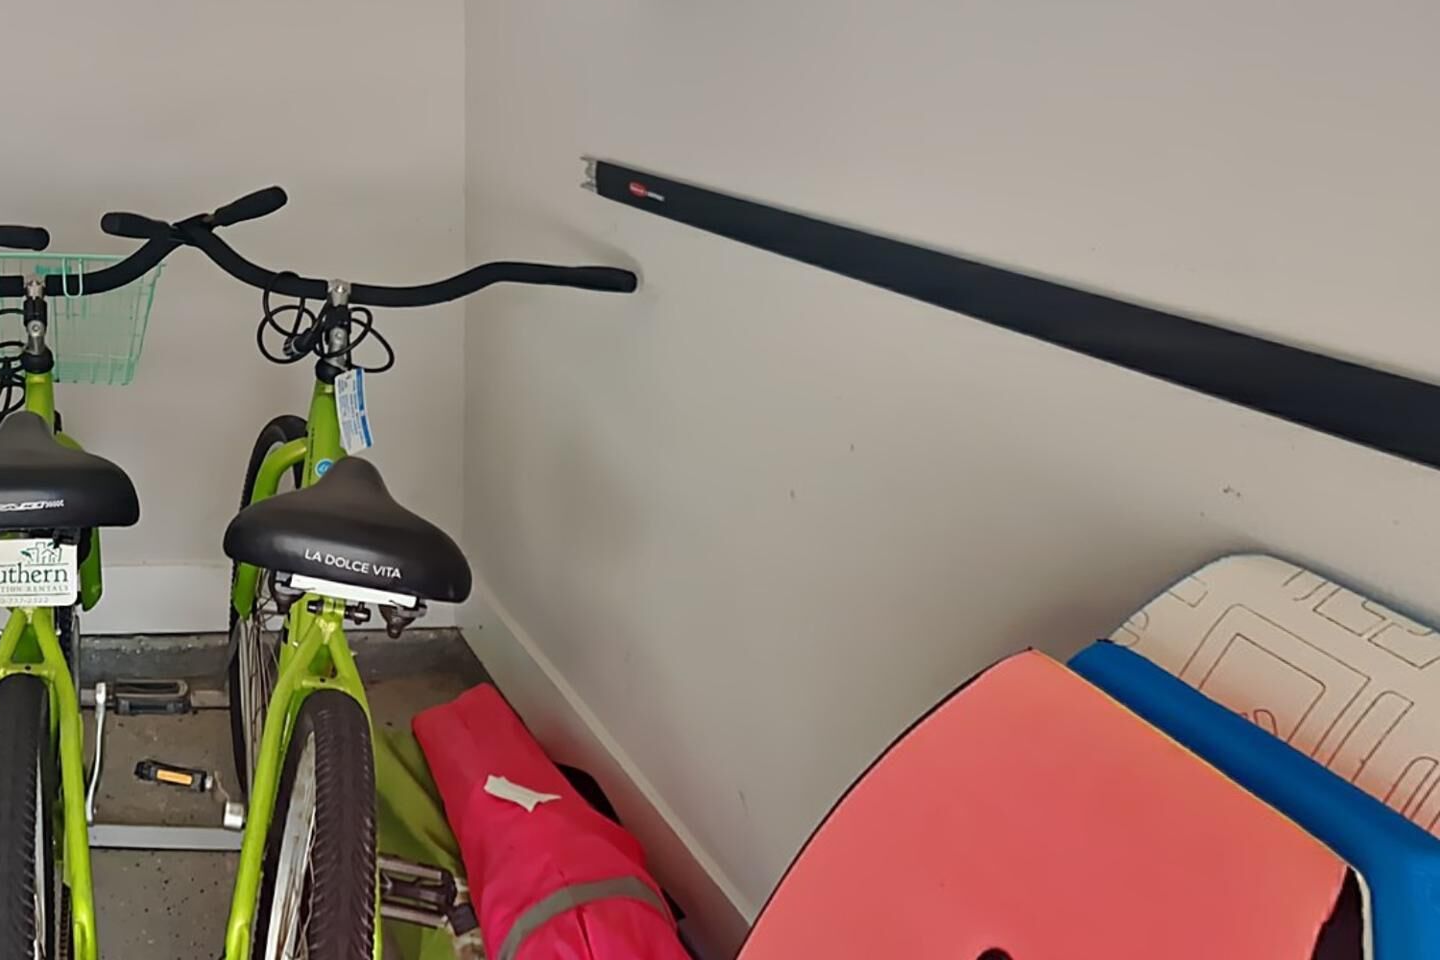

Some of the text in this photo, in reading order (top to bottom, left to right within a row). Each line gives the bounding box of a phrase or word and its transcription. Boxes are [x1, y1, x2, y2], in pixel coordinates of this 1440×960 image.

[304, 548, 402, 579] LA DOLCE VITA
